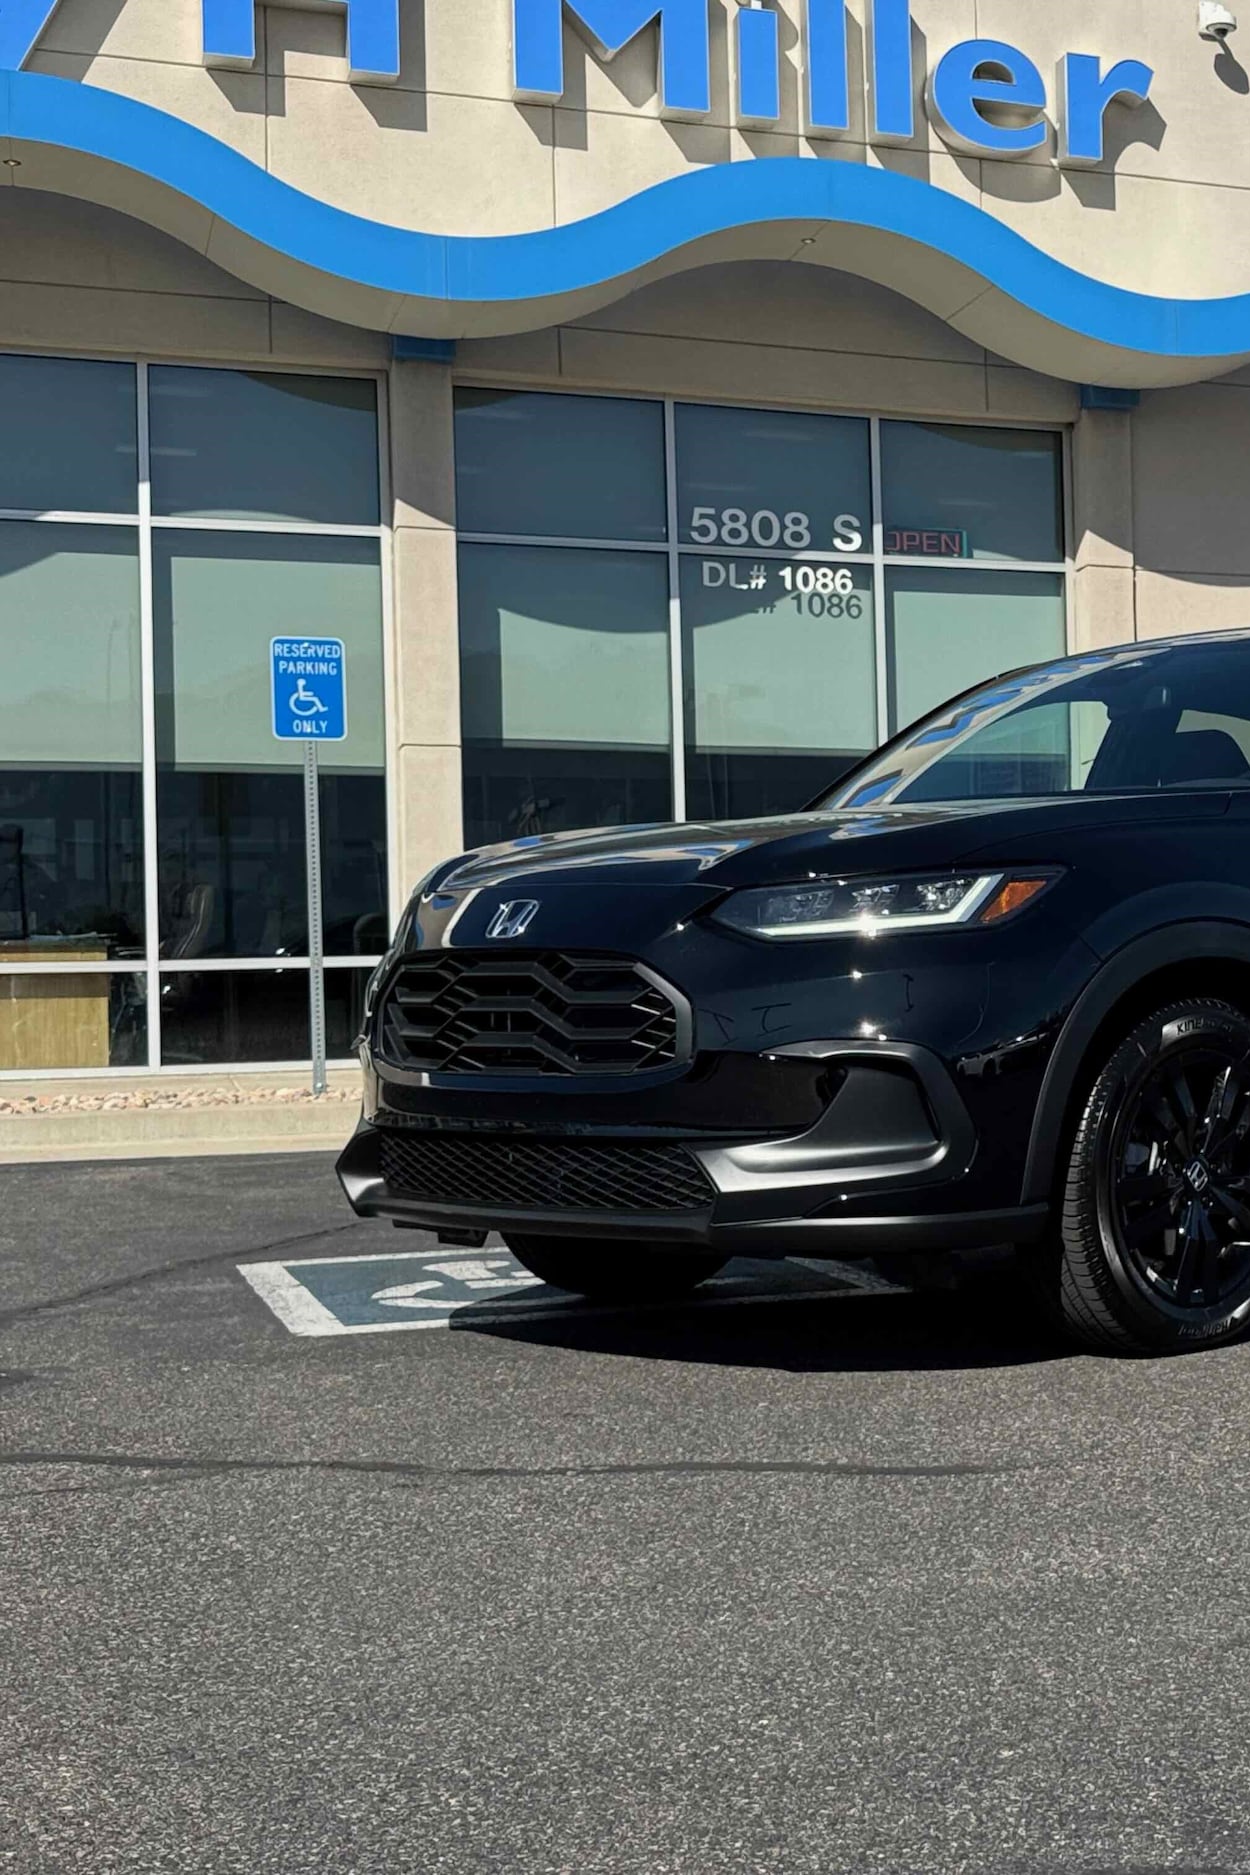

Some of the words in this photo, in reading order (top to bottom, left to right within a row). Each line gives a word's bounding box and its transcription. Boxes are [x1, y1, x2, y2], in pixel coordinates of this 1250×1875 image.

[513, 0, 1154, 165] Miller
[690, 507, 811, 547] 5808
[832, 514, 862, 551] S
[885, 530, 960, 553] OPEN
[702, 561, 767, 590] DL#
[778, 565, 854, 594] 1086
[791, 592, 862, 619] 1086
[274, 643, 340, 657] RESERVED
[279, 661, 337, 674] PARKING
[293, 720, 328, 733] ONLY
